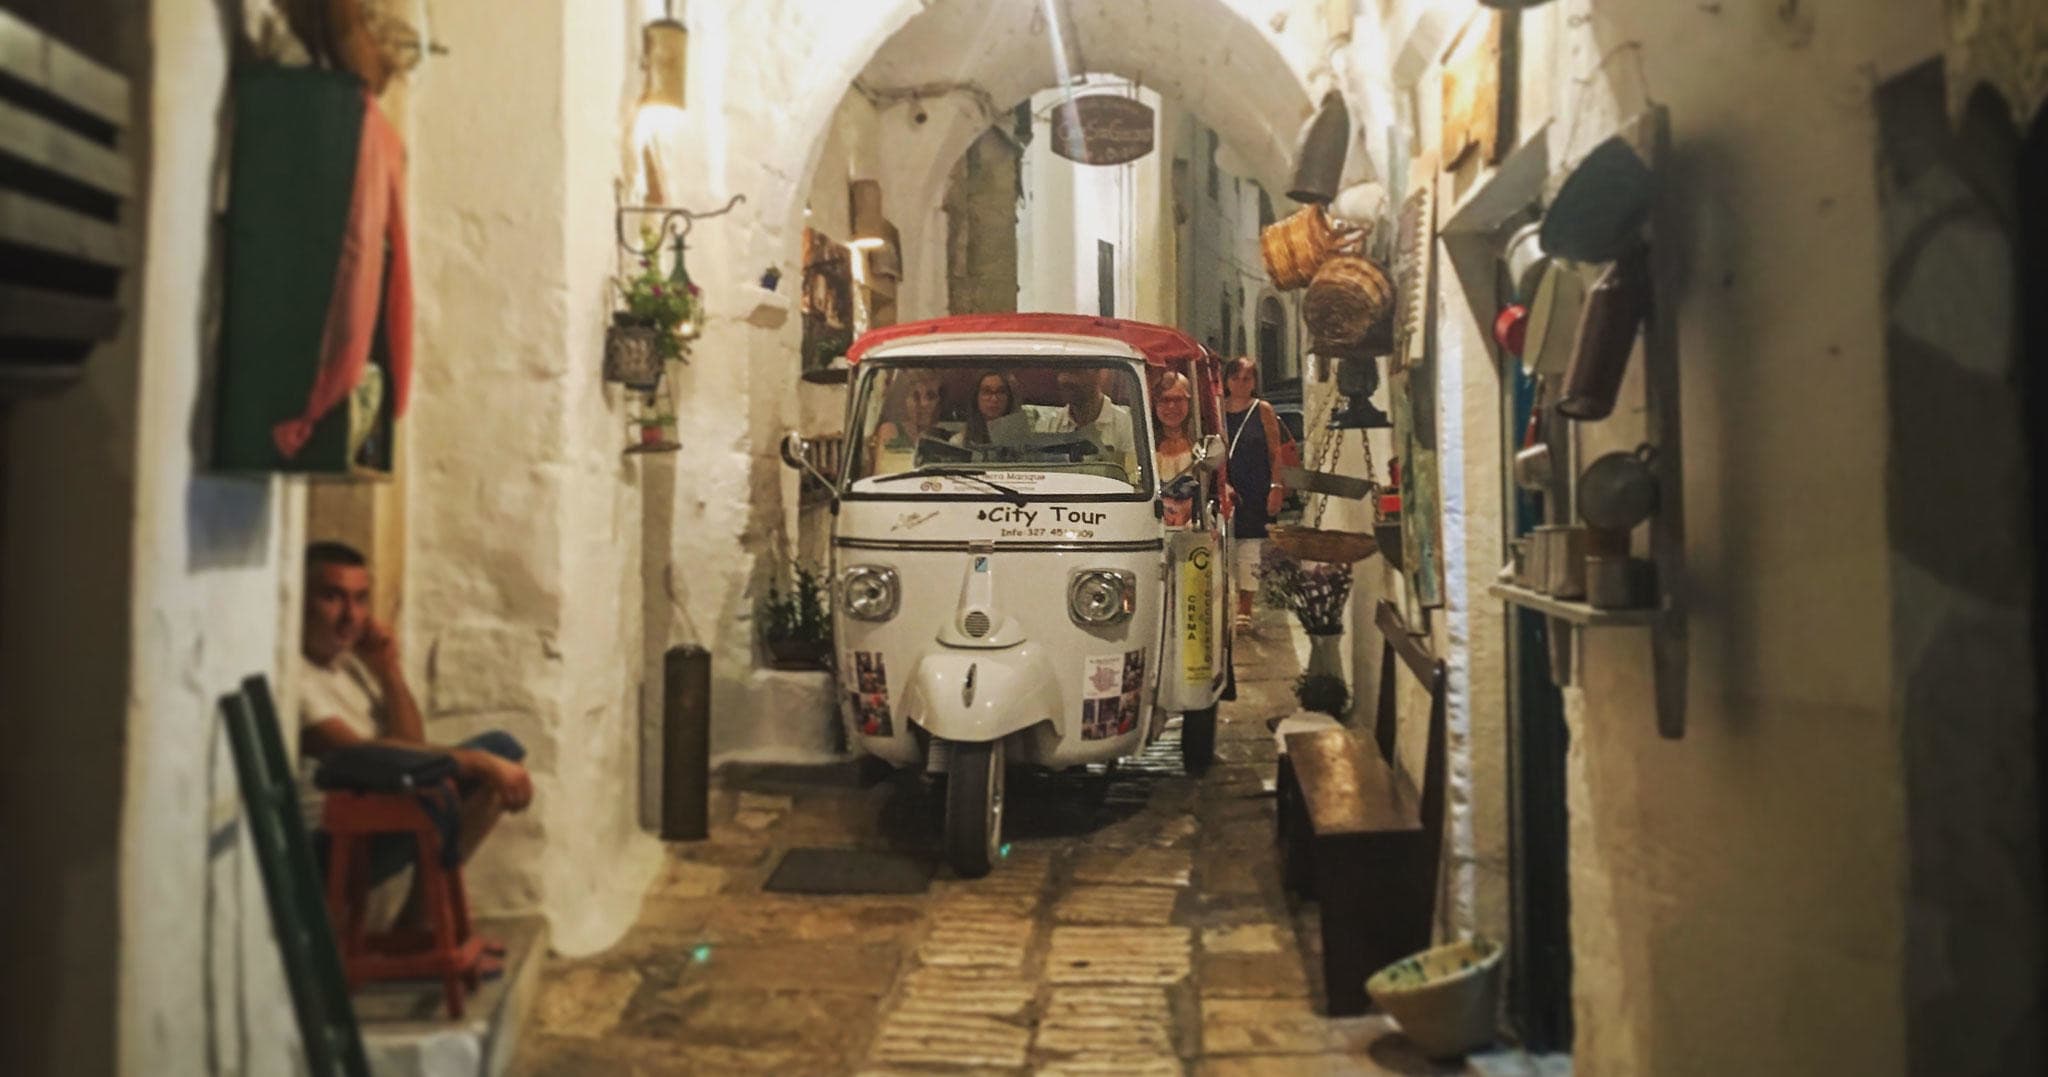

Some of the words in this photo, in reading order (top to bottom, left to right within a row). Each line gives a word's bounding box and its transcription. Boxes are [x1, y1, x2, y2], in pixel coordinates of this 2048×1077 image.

[988, 506, 1038, 527] City
[1049, 506, 1107, 525] Tour
[1187, 595, 1197, 641] CREMA
